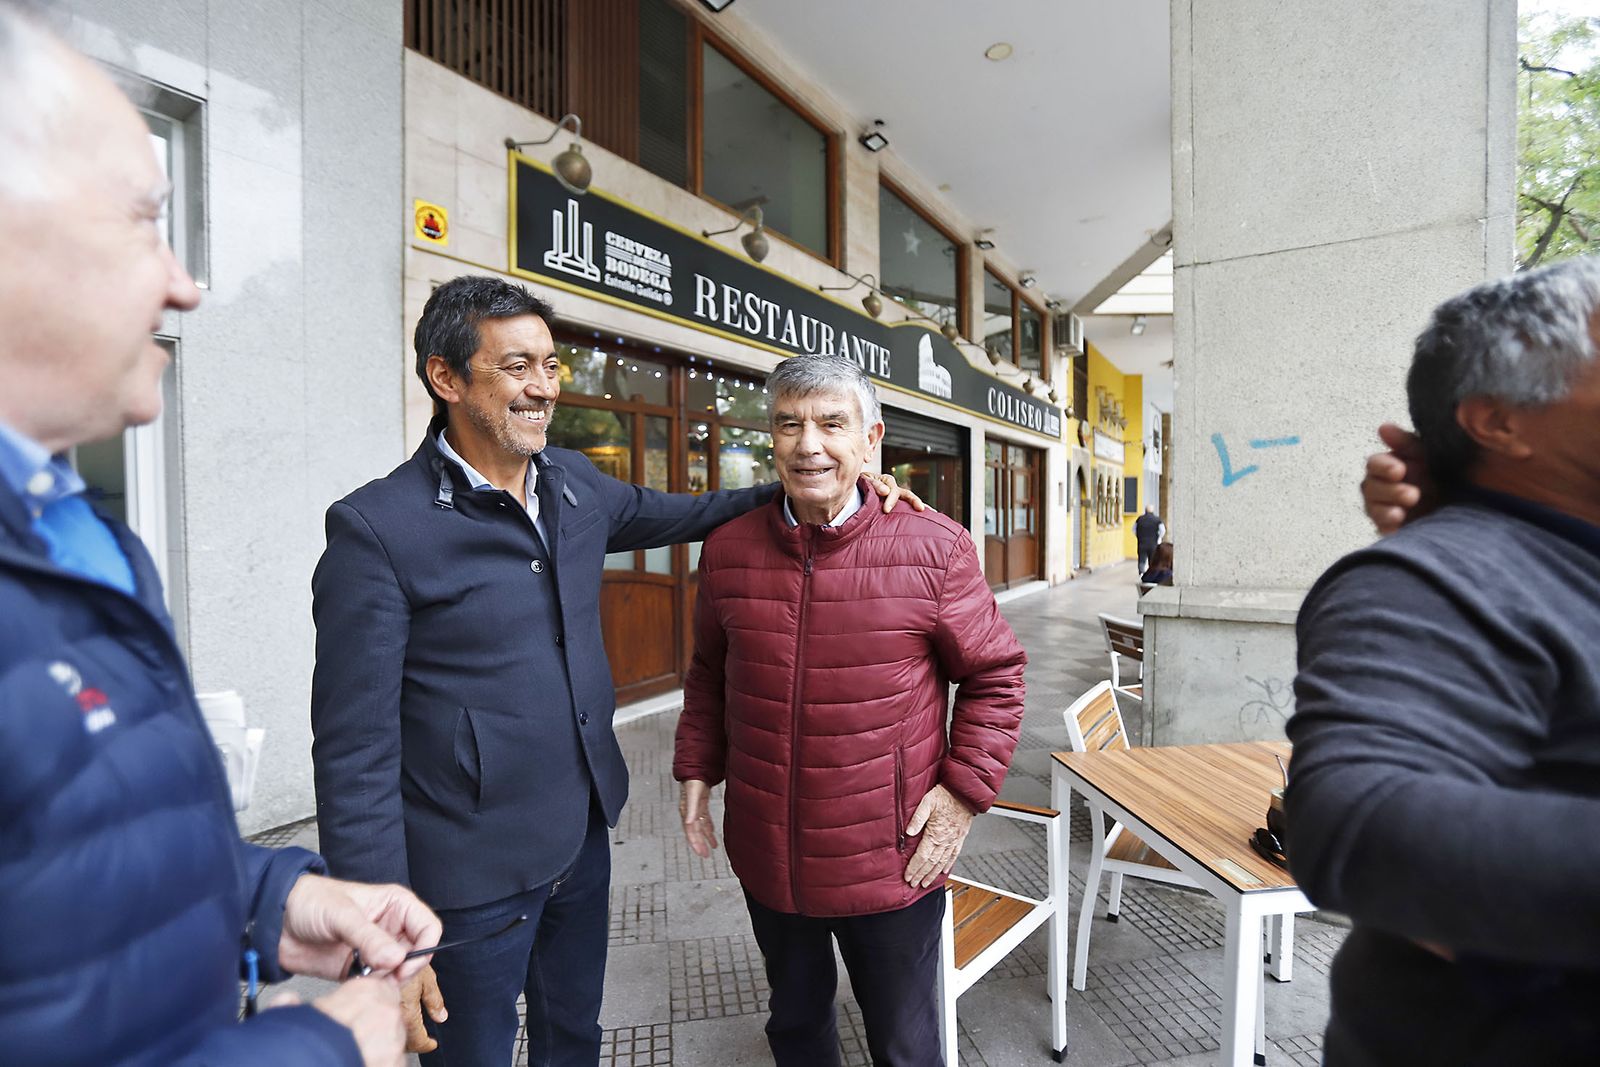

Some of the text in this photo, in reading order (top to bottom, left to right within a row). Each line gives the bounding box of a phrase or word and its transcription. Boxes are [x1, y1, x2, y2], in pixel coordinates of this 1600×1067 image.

[605, 231, 671, 267] CERVEZA
[605, 256, 671, 292] BODEGA
[693, 272, 891, 379] RESTAURANTE
[988, 387, 1042, 431] COLISEO
